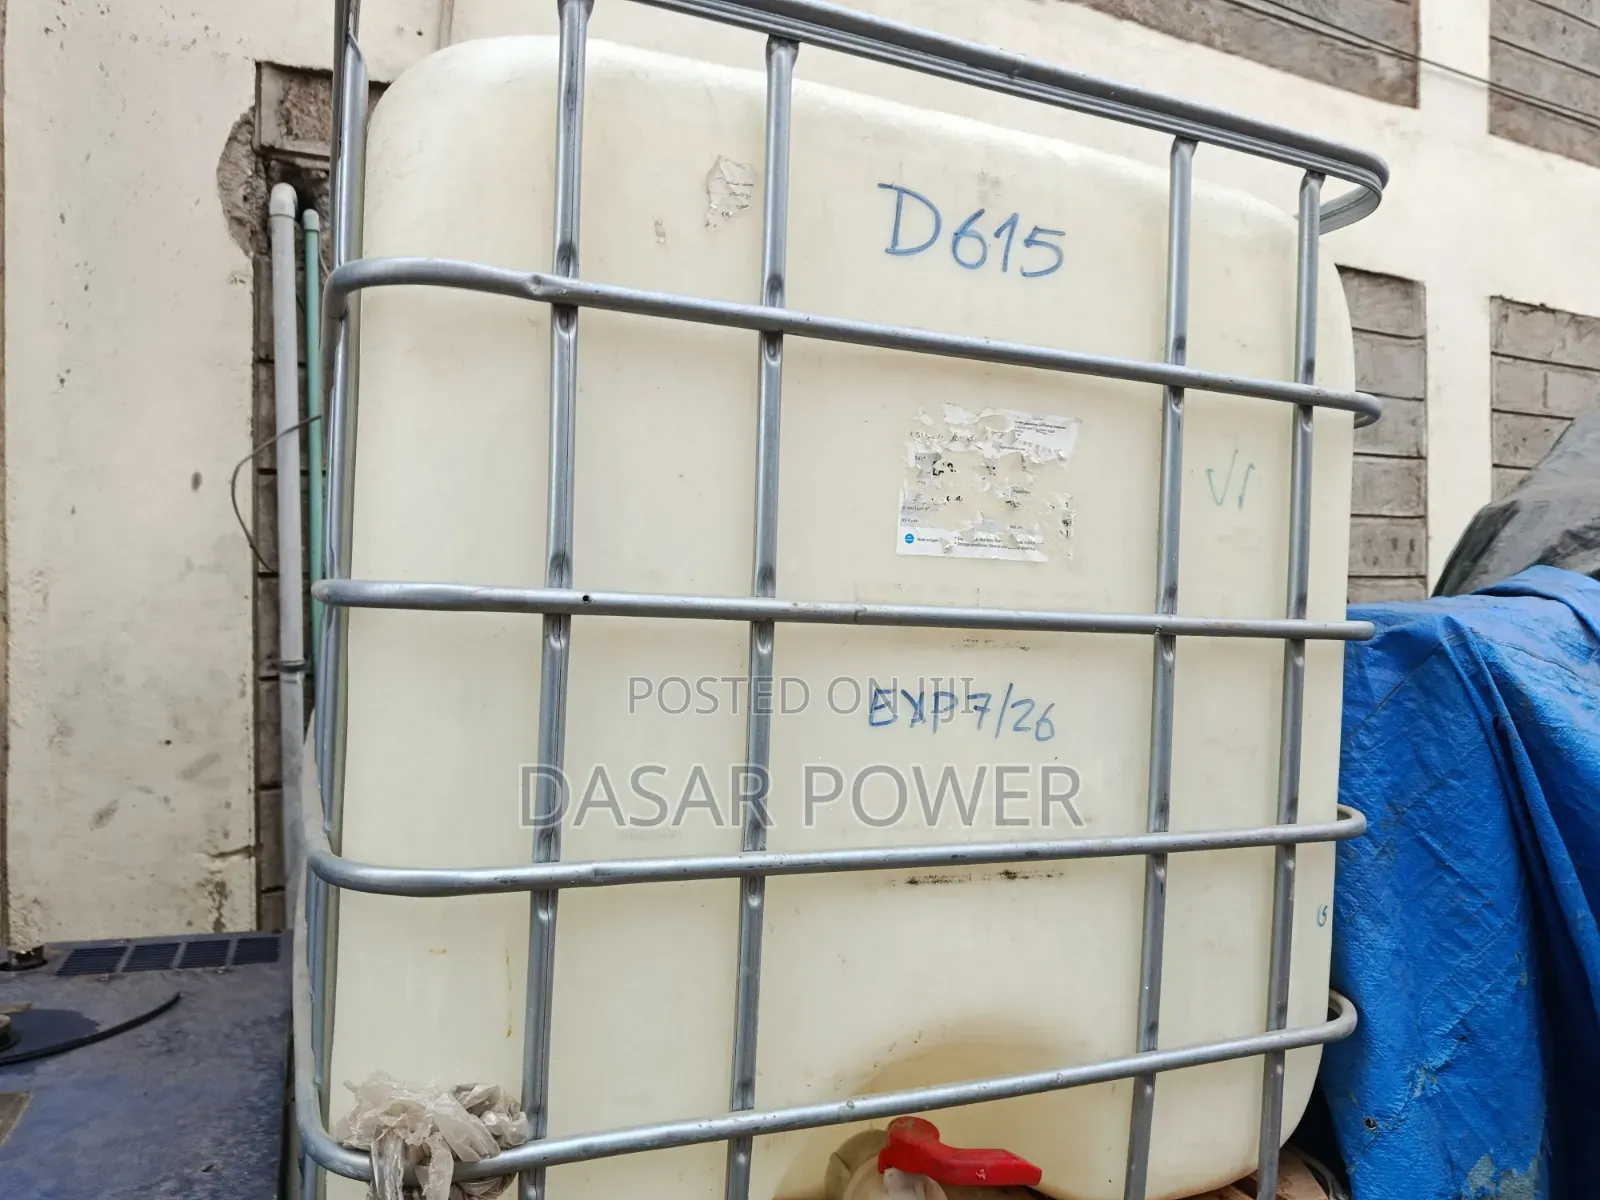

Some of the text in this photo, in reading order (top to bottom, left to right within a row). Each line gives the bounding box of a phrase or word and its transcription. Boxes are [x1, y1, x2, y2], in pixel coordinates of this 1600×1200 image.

[877, 182, 1066, 278] D615
[868, 682, 1056, 742] EXP 7/26
